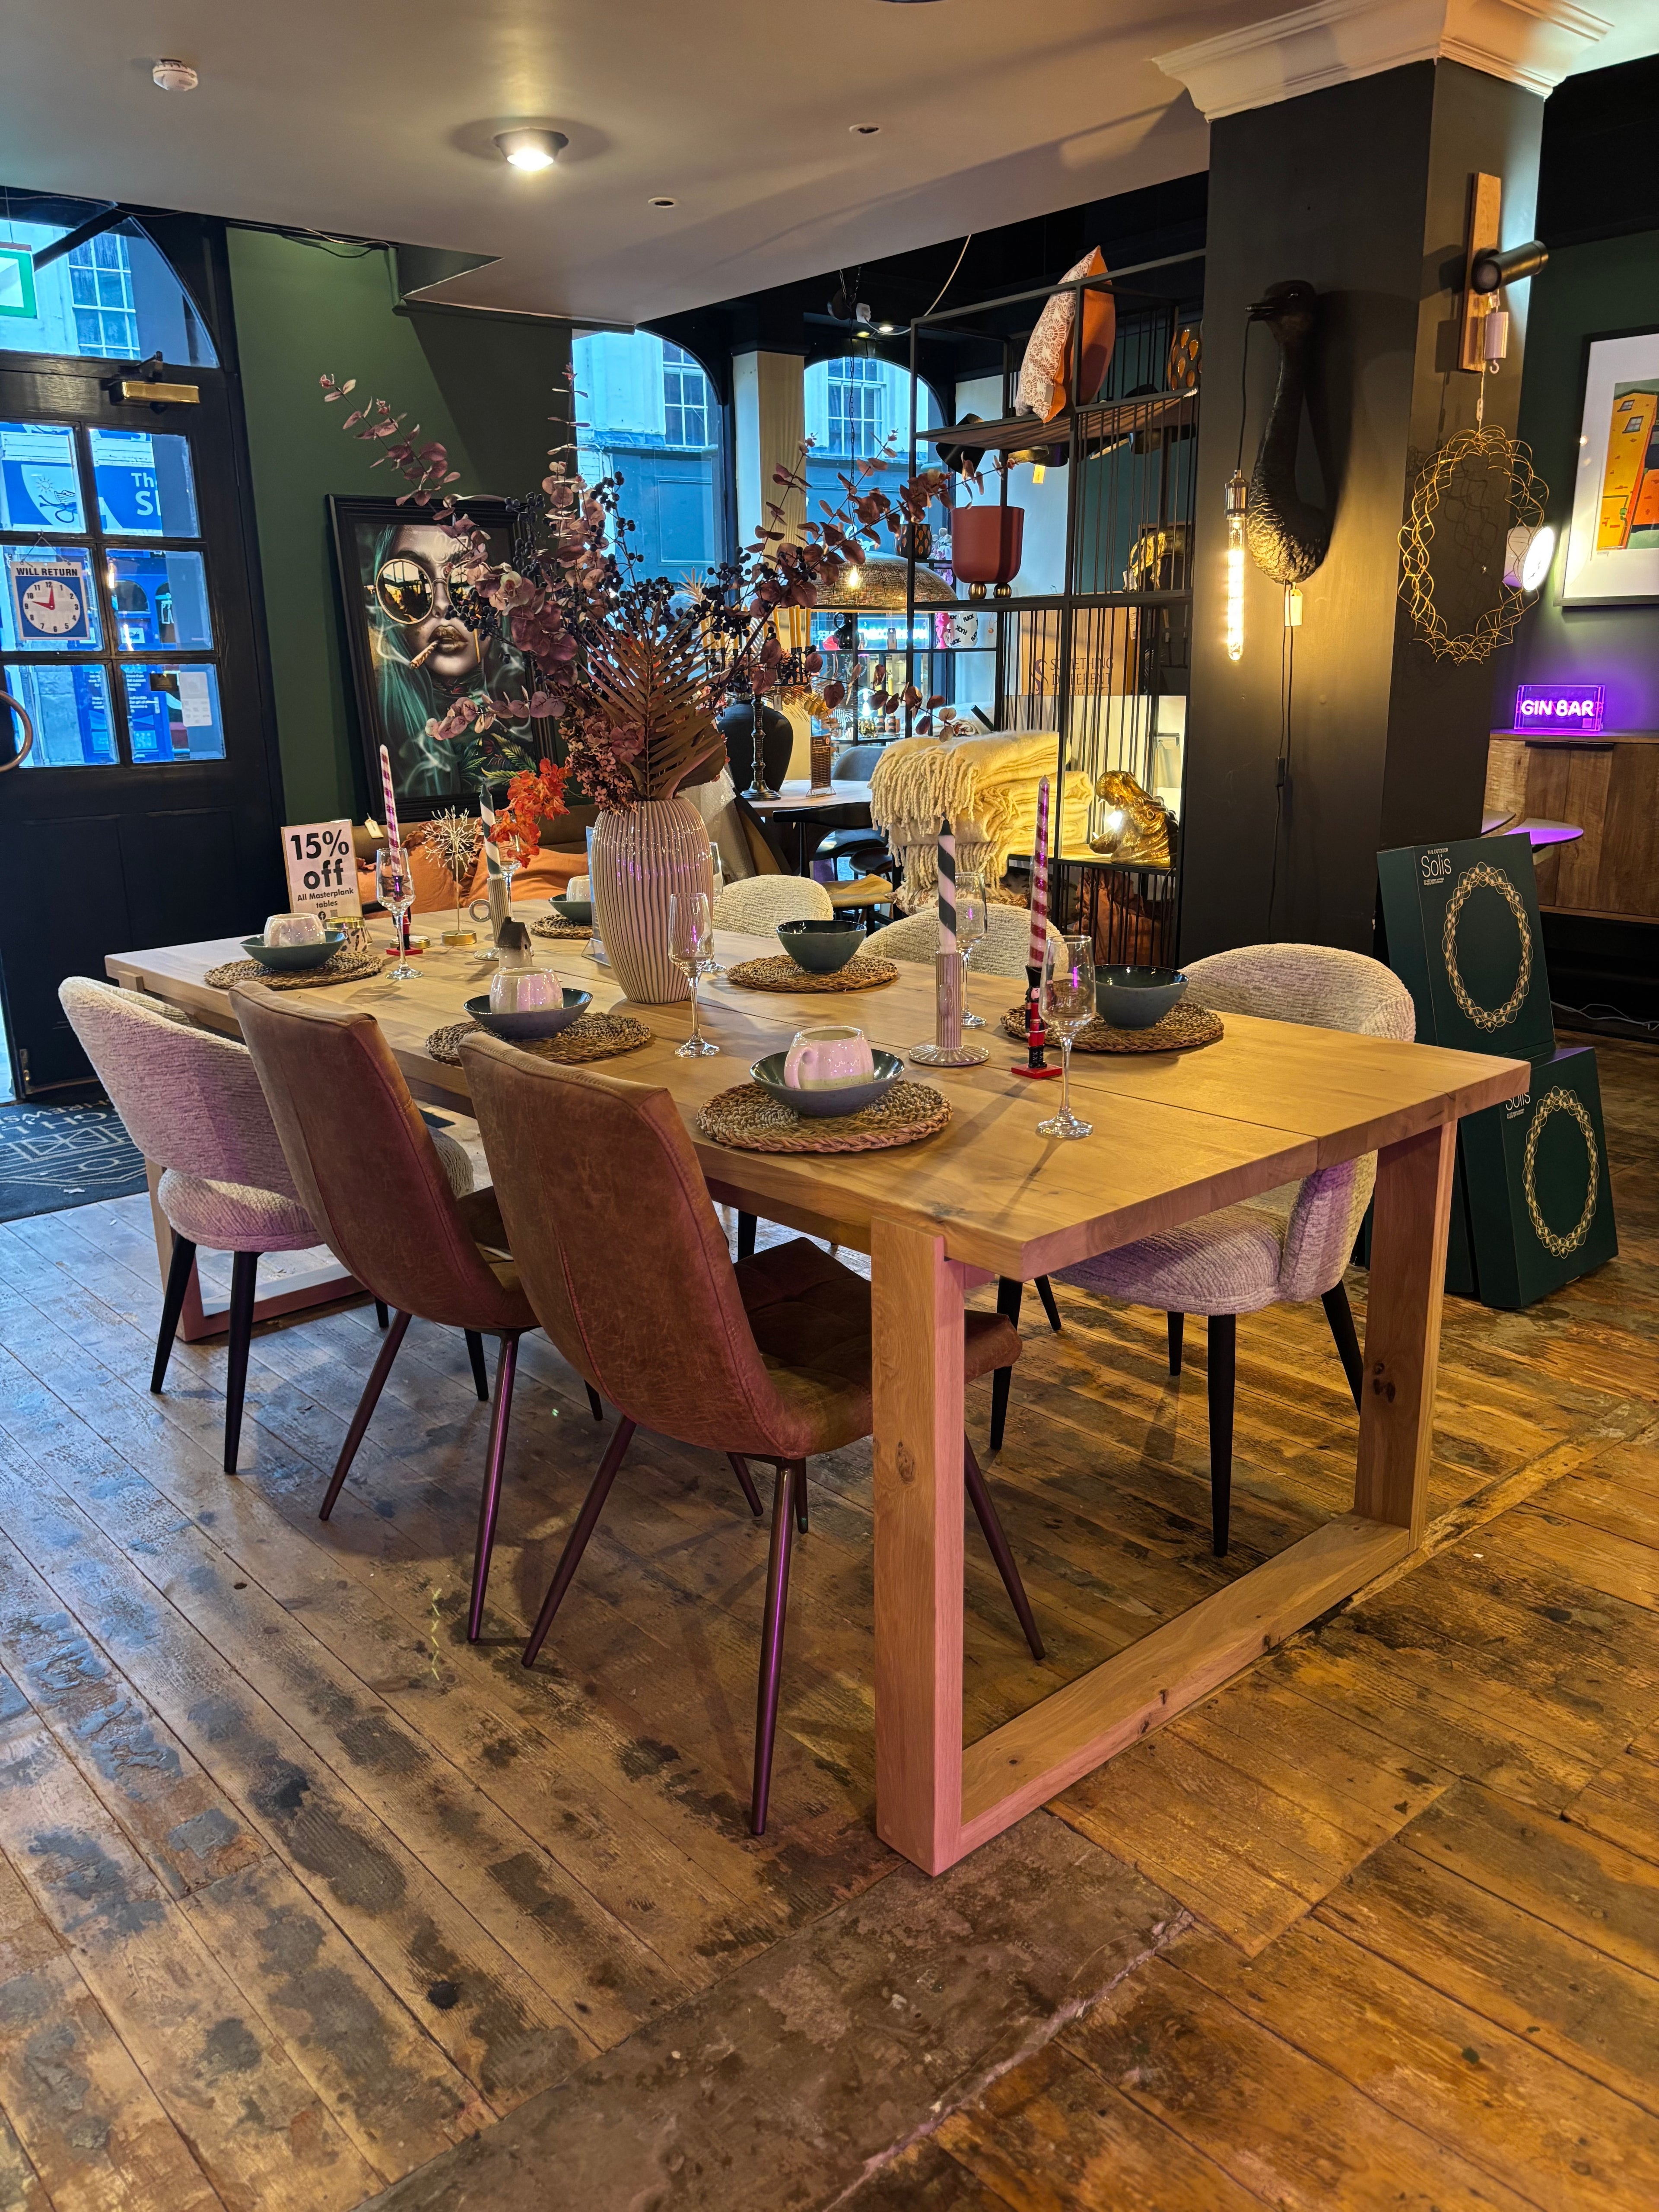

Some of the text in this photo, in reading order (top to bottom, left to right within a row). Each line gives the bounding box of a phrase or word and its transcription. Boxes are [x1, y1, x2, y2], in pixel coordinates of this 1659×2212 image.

[131, 472, 157, 487] Th
[963, 613, 975, 622] FUCK
[955, 625, 968, 635] FUCK
[1521, 699, 1595, 717] GIN BAR
[290, 829, 350, 860] 15%
[1421, 854, 1452, 877] Solis
[303, 858, 344, 890] off
[309, 887, 354, 900] Masterplank
[316, 900, 338, 909] tables
